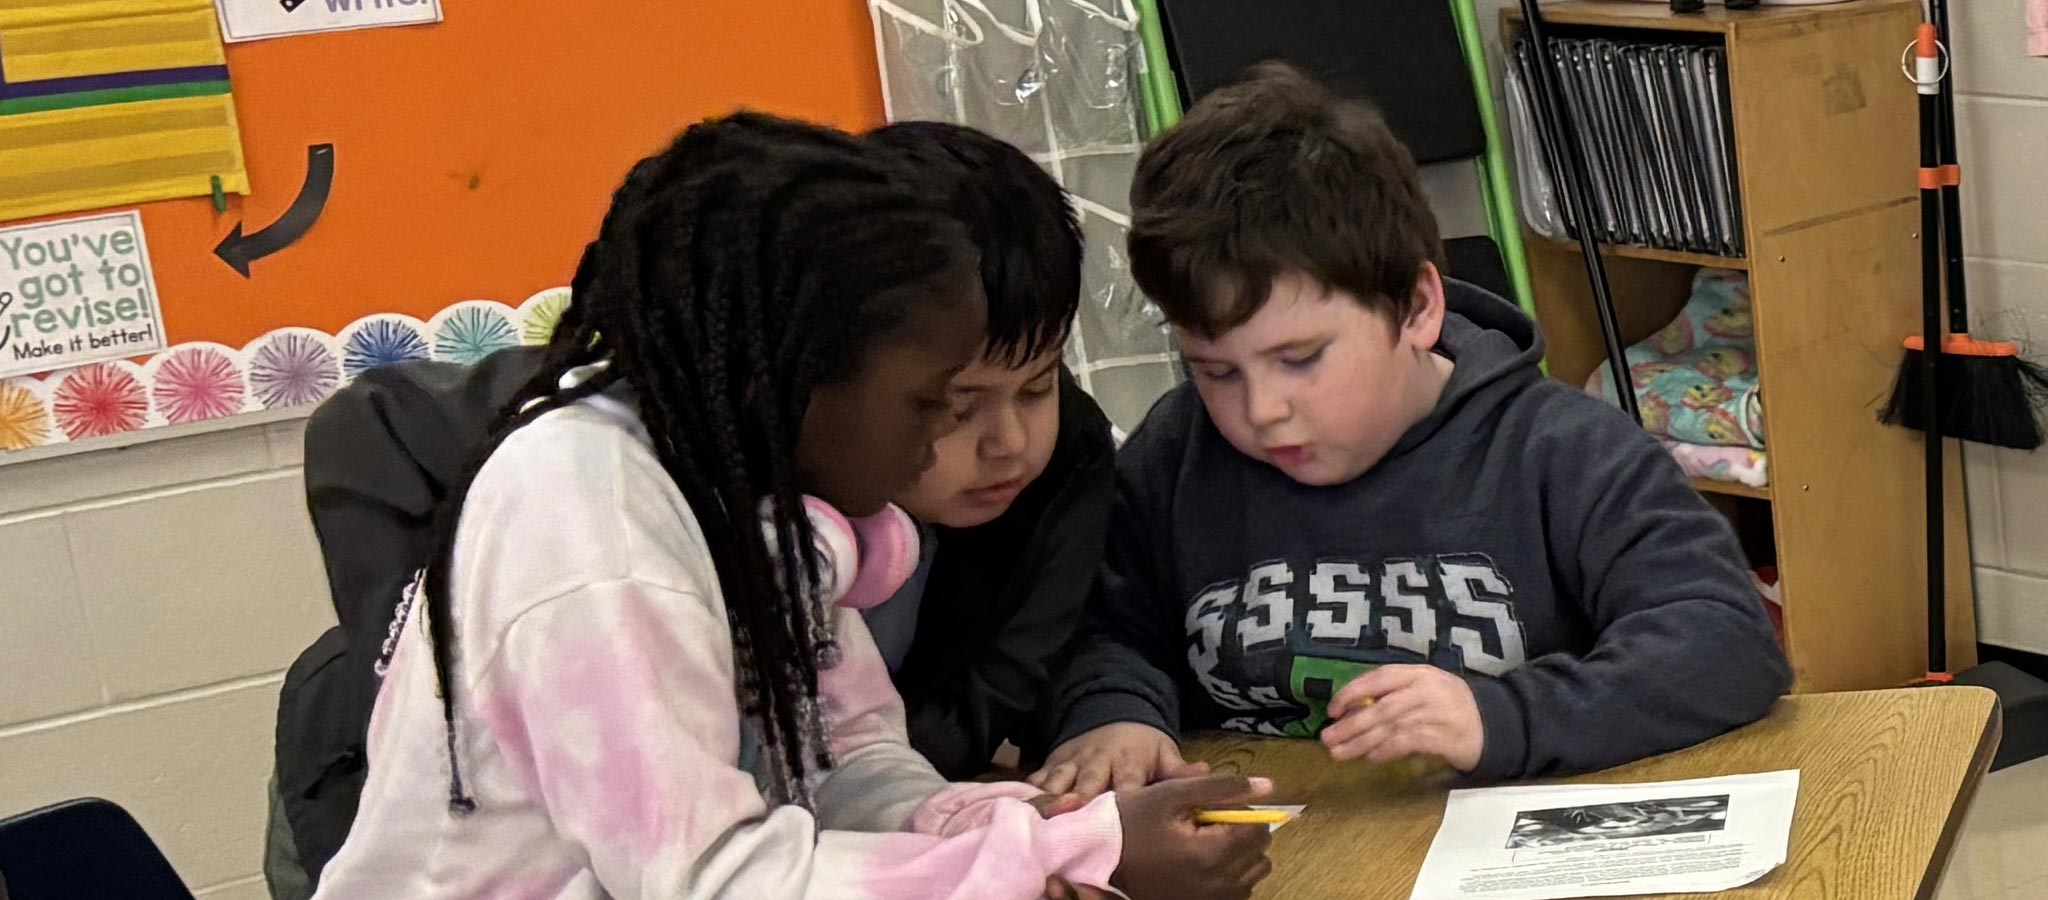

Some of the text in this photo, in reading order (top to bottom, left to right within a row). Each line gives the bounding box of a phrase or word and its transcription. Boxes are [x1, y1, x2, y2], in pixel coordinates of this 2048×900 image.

[0, 230, 135, 271] You've
[18, 259, 141, 310] got to
[10, 288, 150, 338] revise!
[13, 323, 153, 360] Make it better!
